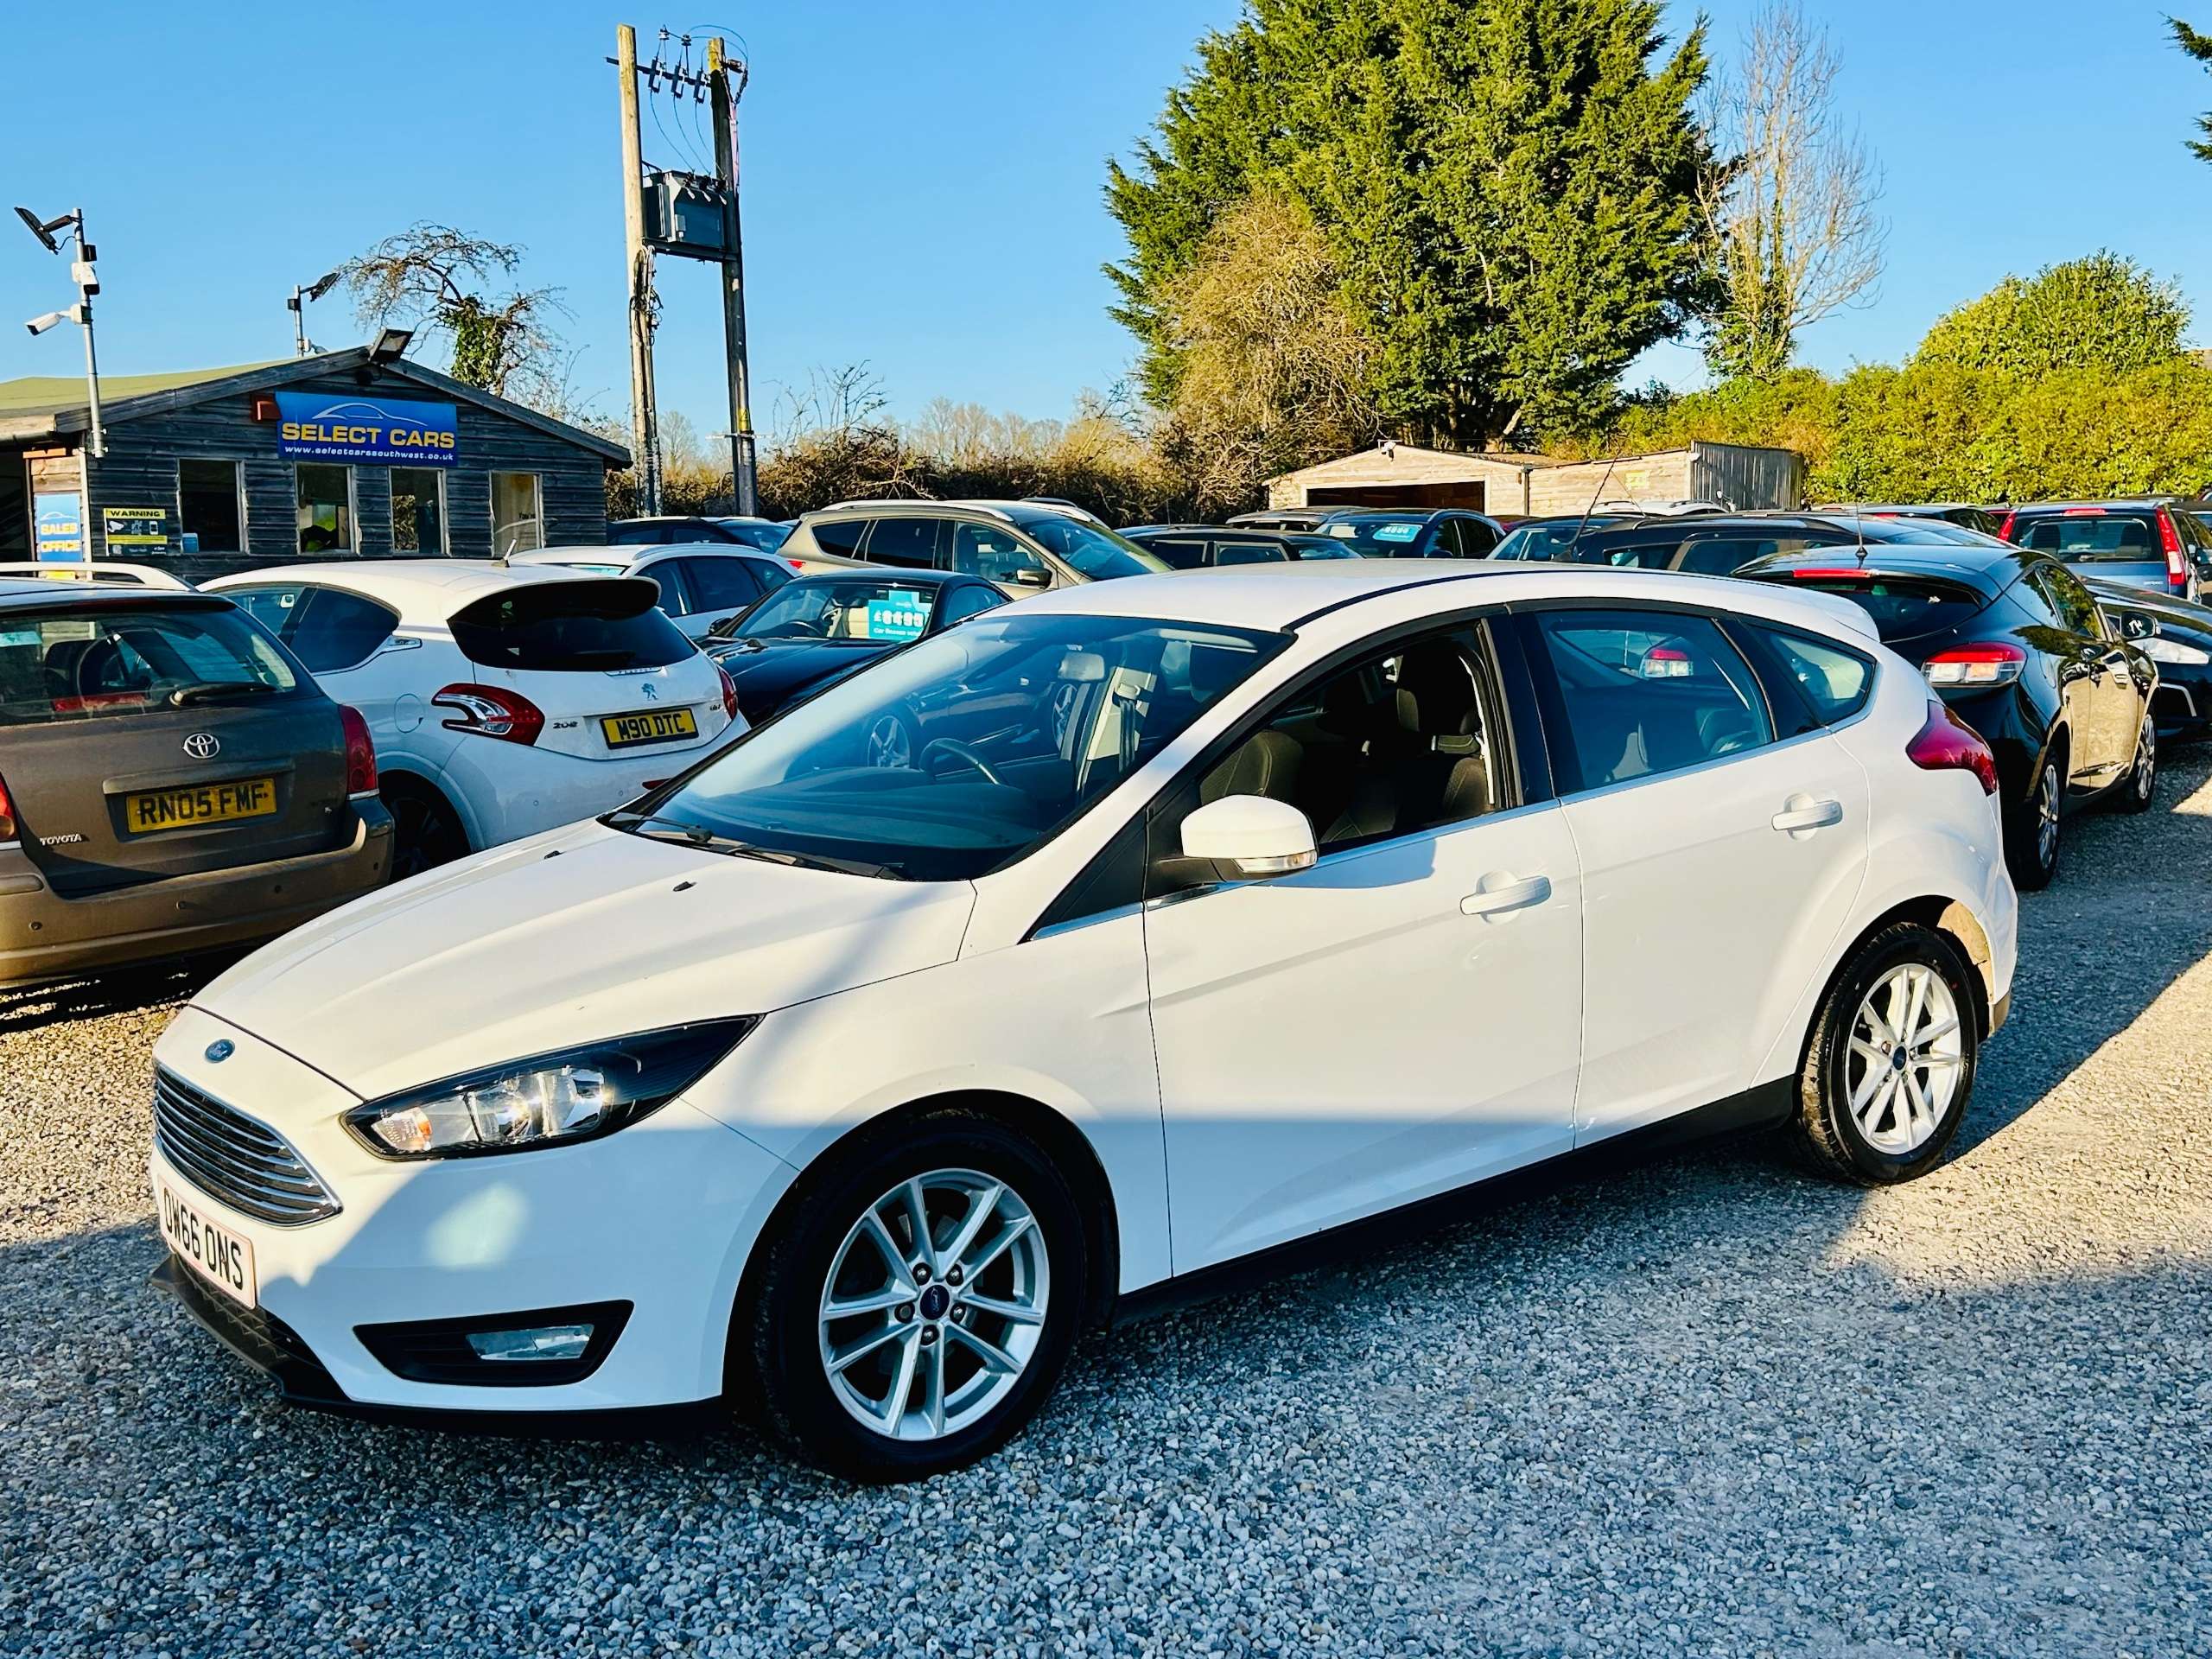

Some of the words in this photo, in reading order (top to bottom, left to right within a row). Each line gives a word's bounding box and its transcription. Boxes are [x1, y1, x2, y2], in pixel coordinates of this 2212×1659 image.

[282, 423, 381, 443] SELECT
[389, 429, 455, 448] CARS
[284, 446, 454, 460] www.selectcarssouthwest.co.uk
[41, 523, 78, 535] SALES
[41, 540, 80, 552] OFFICE
[616, 719, 652, 740] M90
[656, 713, 685, 734] DTC
[140, 793, 212, 826] RN05
[219, 785, 266, 815] FMF
[40, 833, 82, 846] TOYOTA
[163, 1186, 201, 1261] OW66
[205, 1223, 244, 1291] ONS
